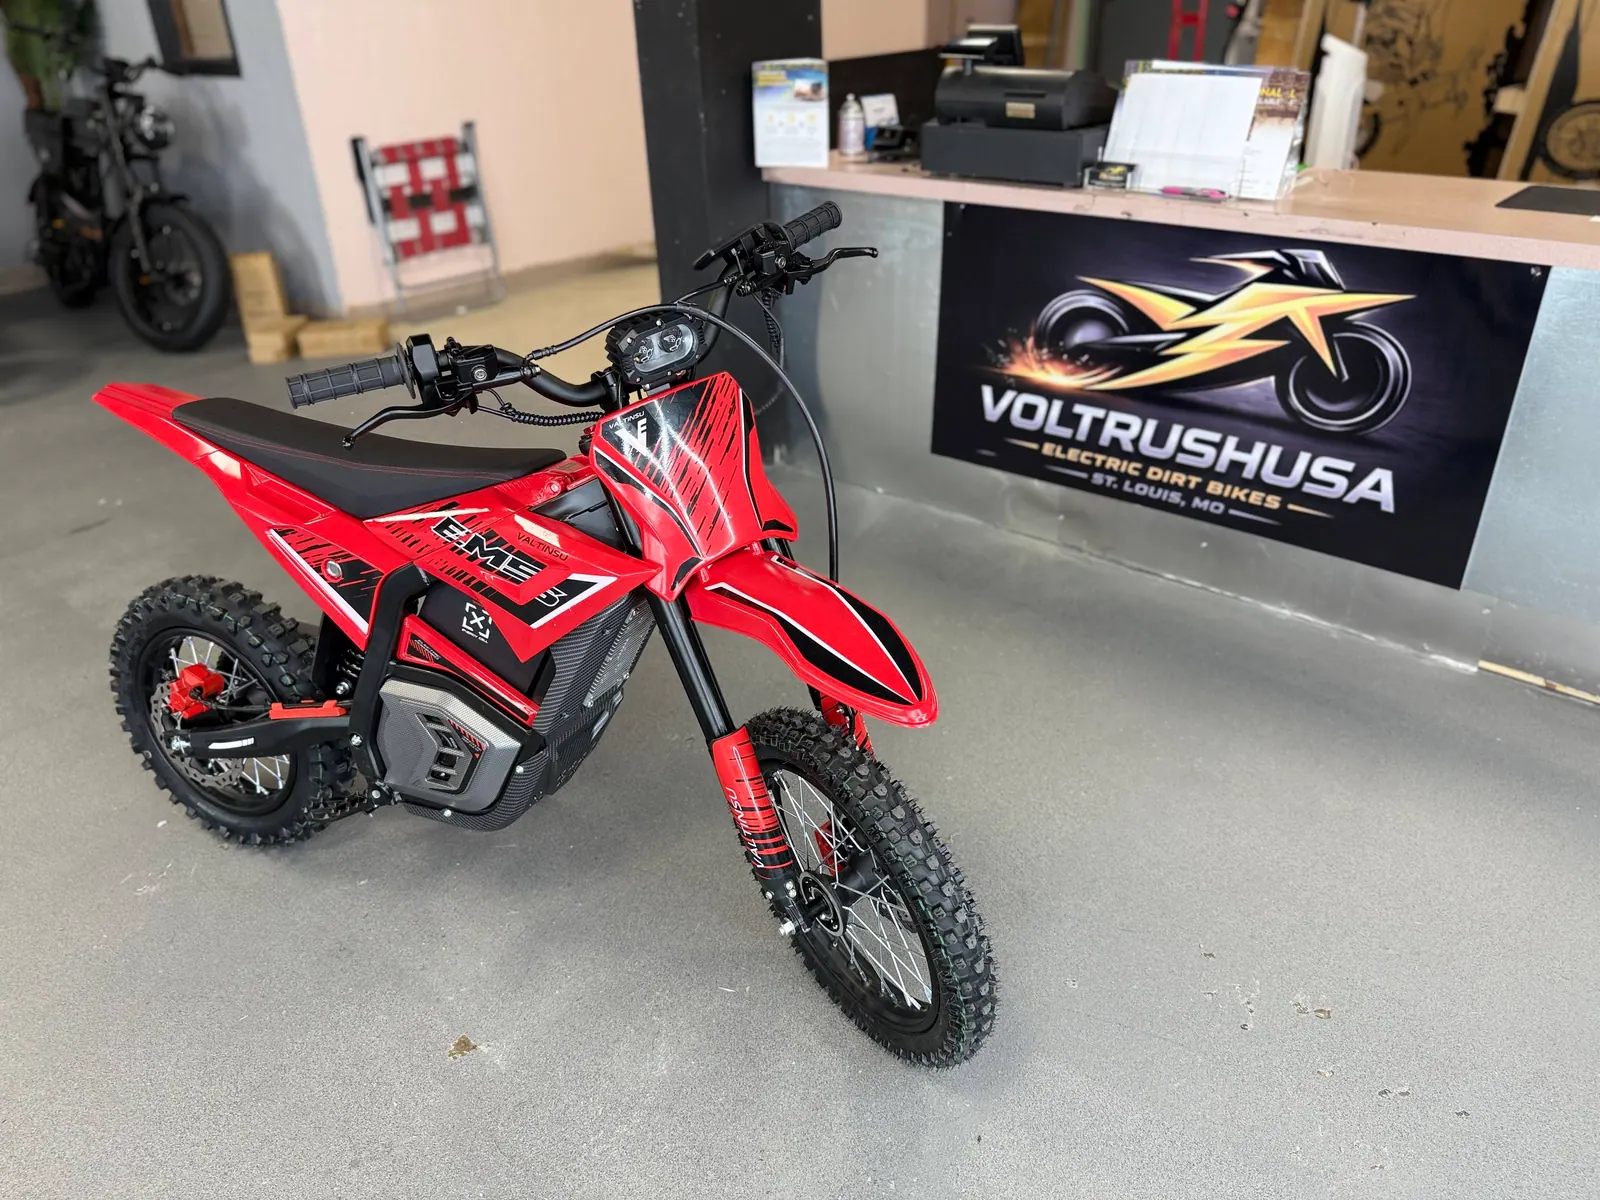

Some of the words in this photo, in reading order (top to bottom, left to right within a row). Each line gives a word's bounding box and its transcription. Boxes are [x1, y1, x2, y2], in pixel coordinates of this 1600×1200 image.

[981, 384, 1395, 513] VOLTRUSHUSA
[1041, 442, 1143, 477] ELECTRIC
[1145, 466, 1203, 490] DIRT
[1206, 480, 1283, 510] BIKES
[1091, 472, 1119, 490] ST.
[1122, 480, 1187, 508] LOUIS,
[1191, 496, 1226, 515] MO
[516, 532, 569, 562] VALTINSU
[726, 786, 765, 868] VALTINSU
